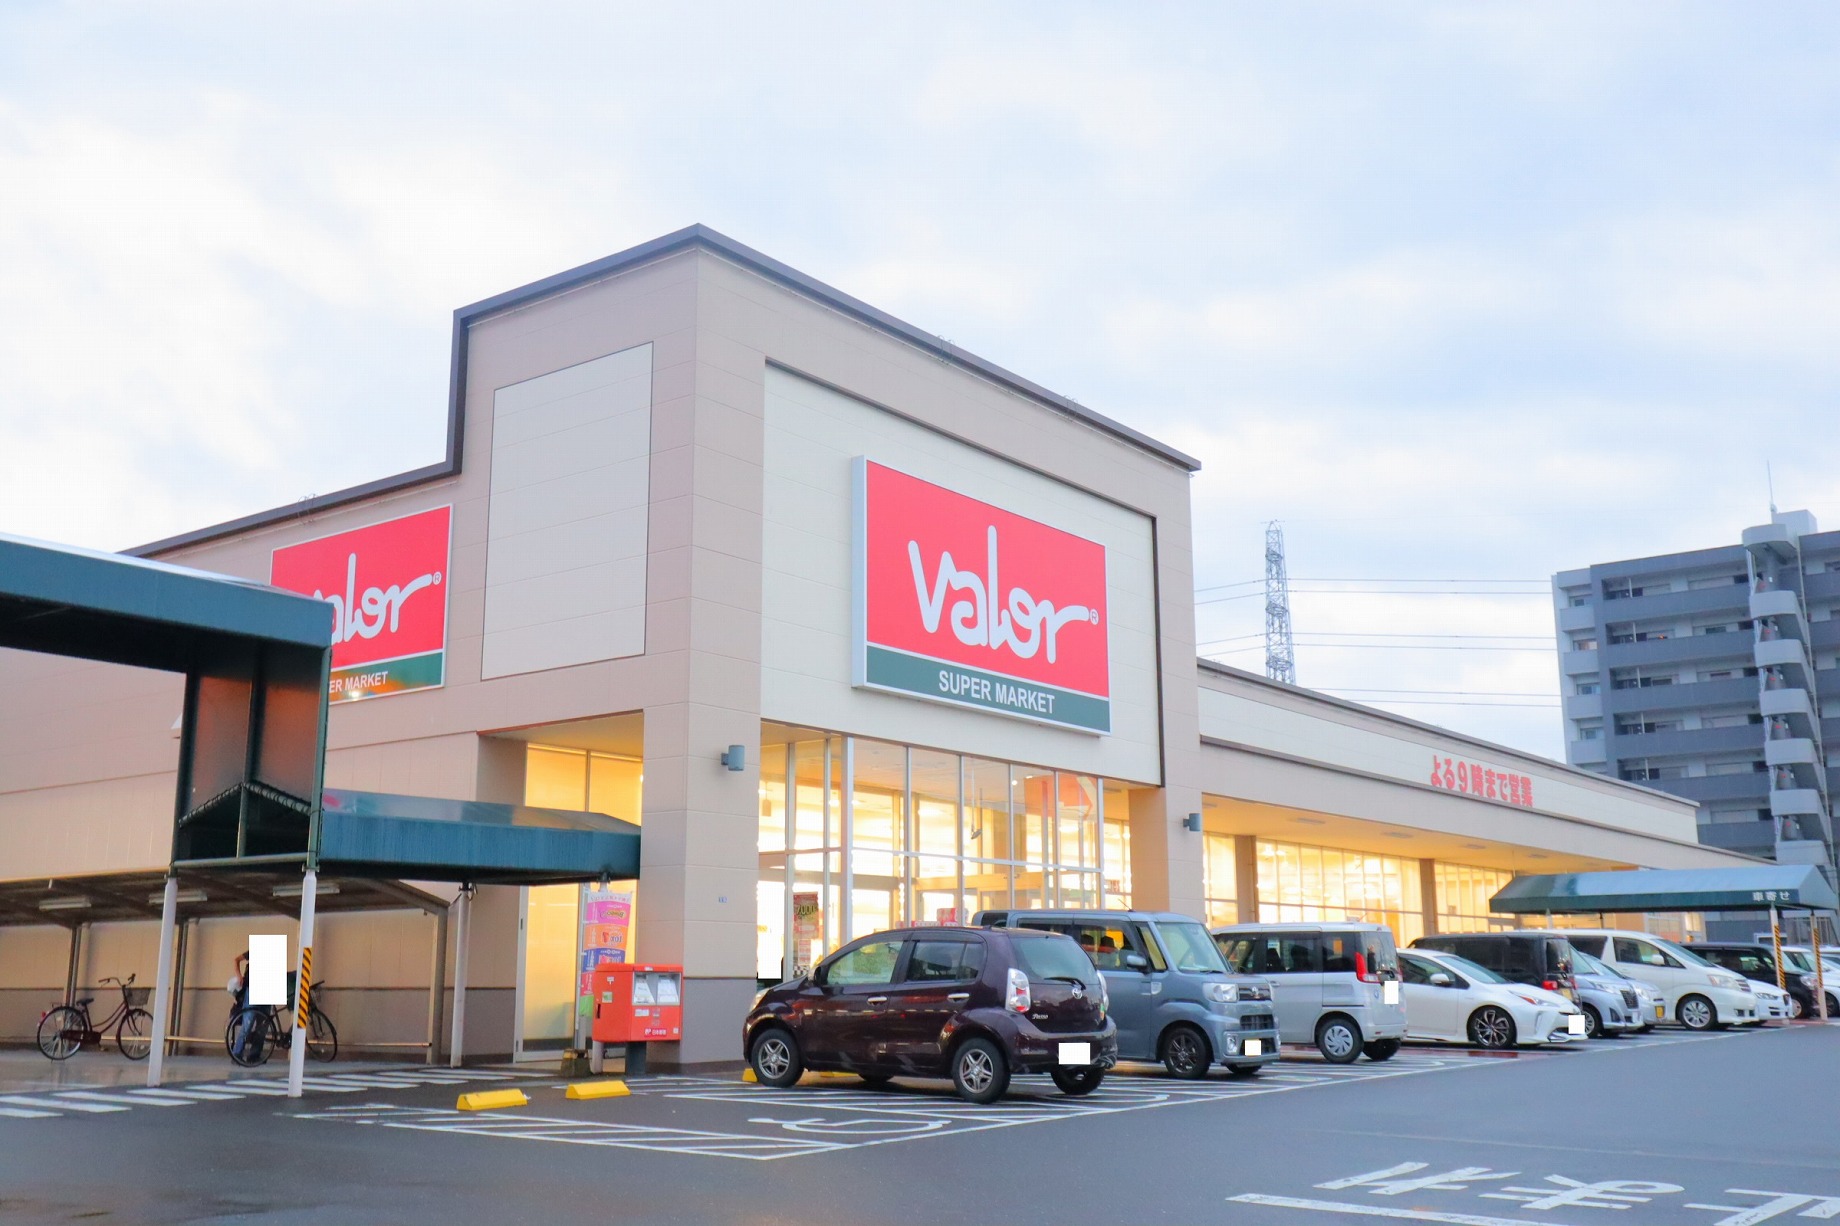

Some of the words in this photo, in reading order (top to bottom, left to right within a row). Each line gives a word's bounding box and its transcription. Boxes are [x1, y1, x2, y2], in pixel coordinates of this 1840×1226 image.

[344, 670, 389, 691] MARKET
[938, 669, 992, 702] SUPER
[995, 681, 1056, 715] MARKET
[1752, 891, 1790, 902] 車寄せ
